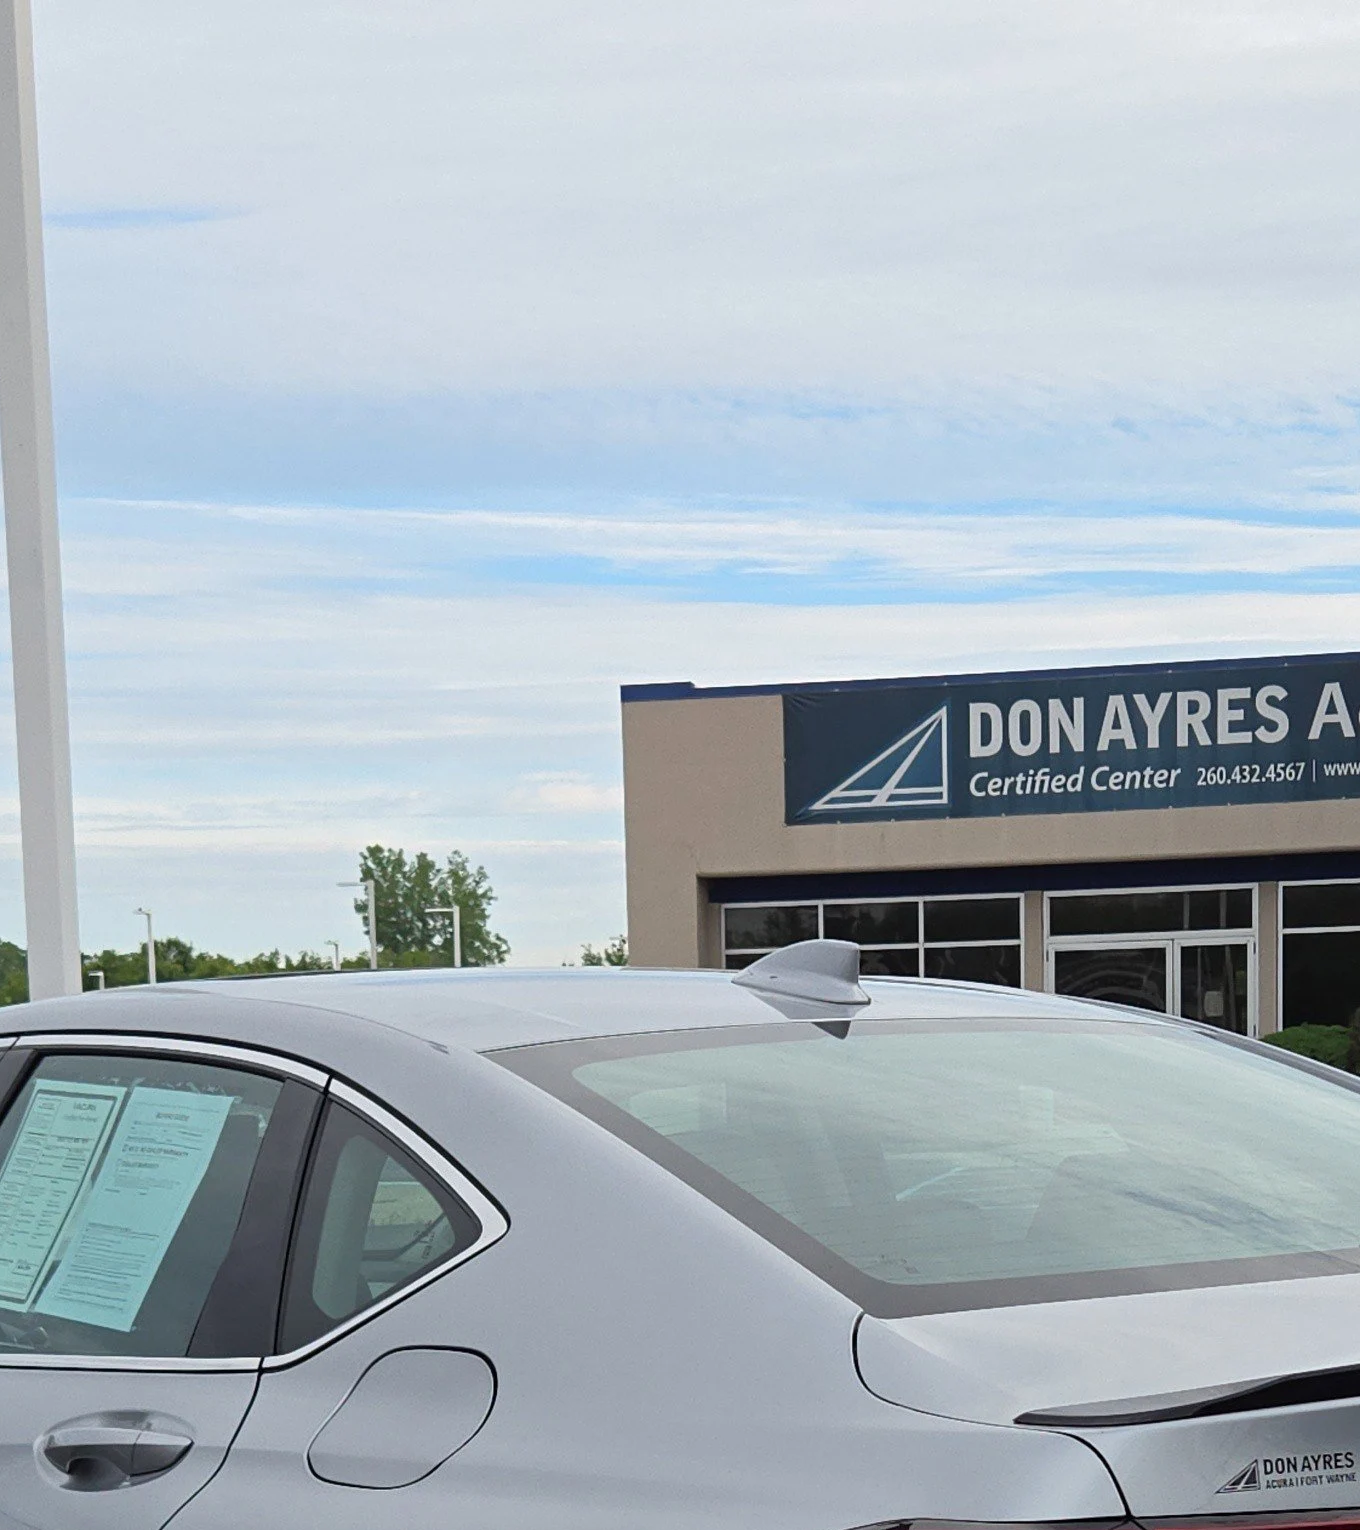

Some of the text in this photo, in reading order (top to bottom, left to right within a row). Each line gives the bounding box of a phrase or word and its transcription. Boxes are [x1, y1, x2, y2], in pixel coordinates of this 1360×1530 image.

[969, 696, 1085, 758] DON
[1097, 684, 1289, 752] AYRES
[969, 765, 1182, 797] Certified Center
[1196, 761, 1306, 786] 260.432.4567
[1263, 1451, 1355, 1475] DON AYRES
[1265, 1472, 1357, 1490] ACURA FORT WAYNE
